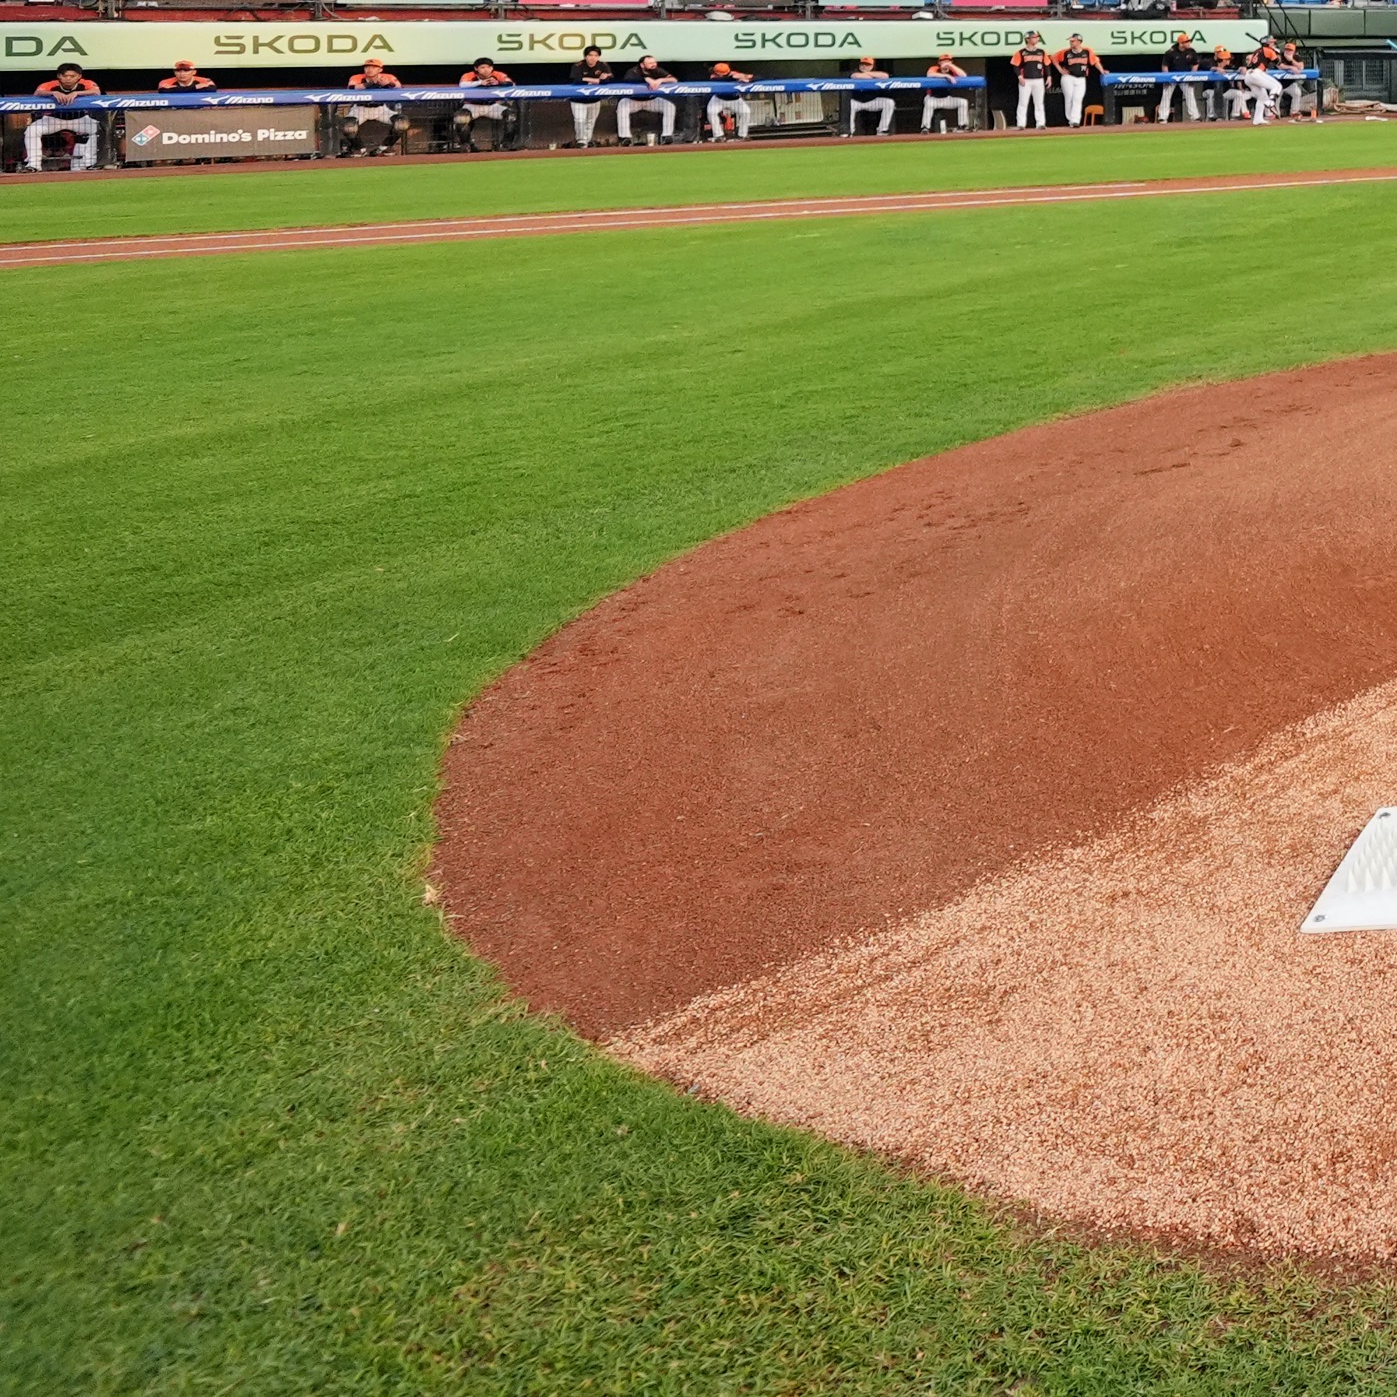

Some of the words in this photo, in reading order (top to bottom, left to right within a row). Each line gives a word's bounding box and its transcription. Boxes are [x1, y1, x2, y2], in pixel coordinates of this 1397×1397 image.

[213, 34, 395, 55] SKODA
[497, 32, 647, 52] SKODA
[734, 32, 862, 49] SKODA
[936, 30, 1046, 47] SKODA
[1111, 30, 1207, 46] SKODA
[162, 129, 251, 145] Domino's
[257, 127, 307, 142] Pizza
